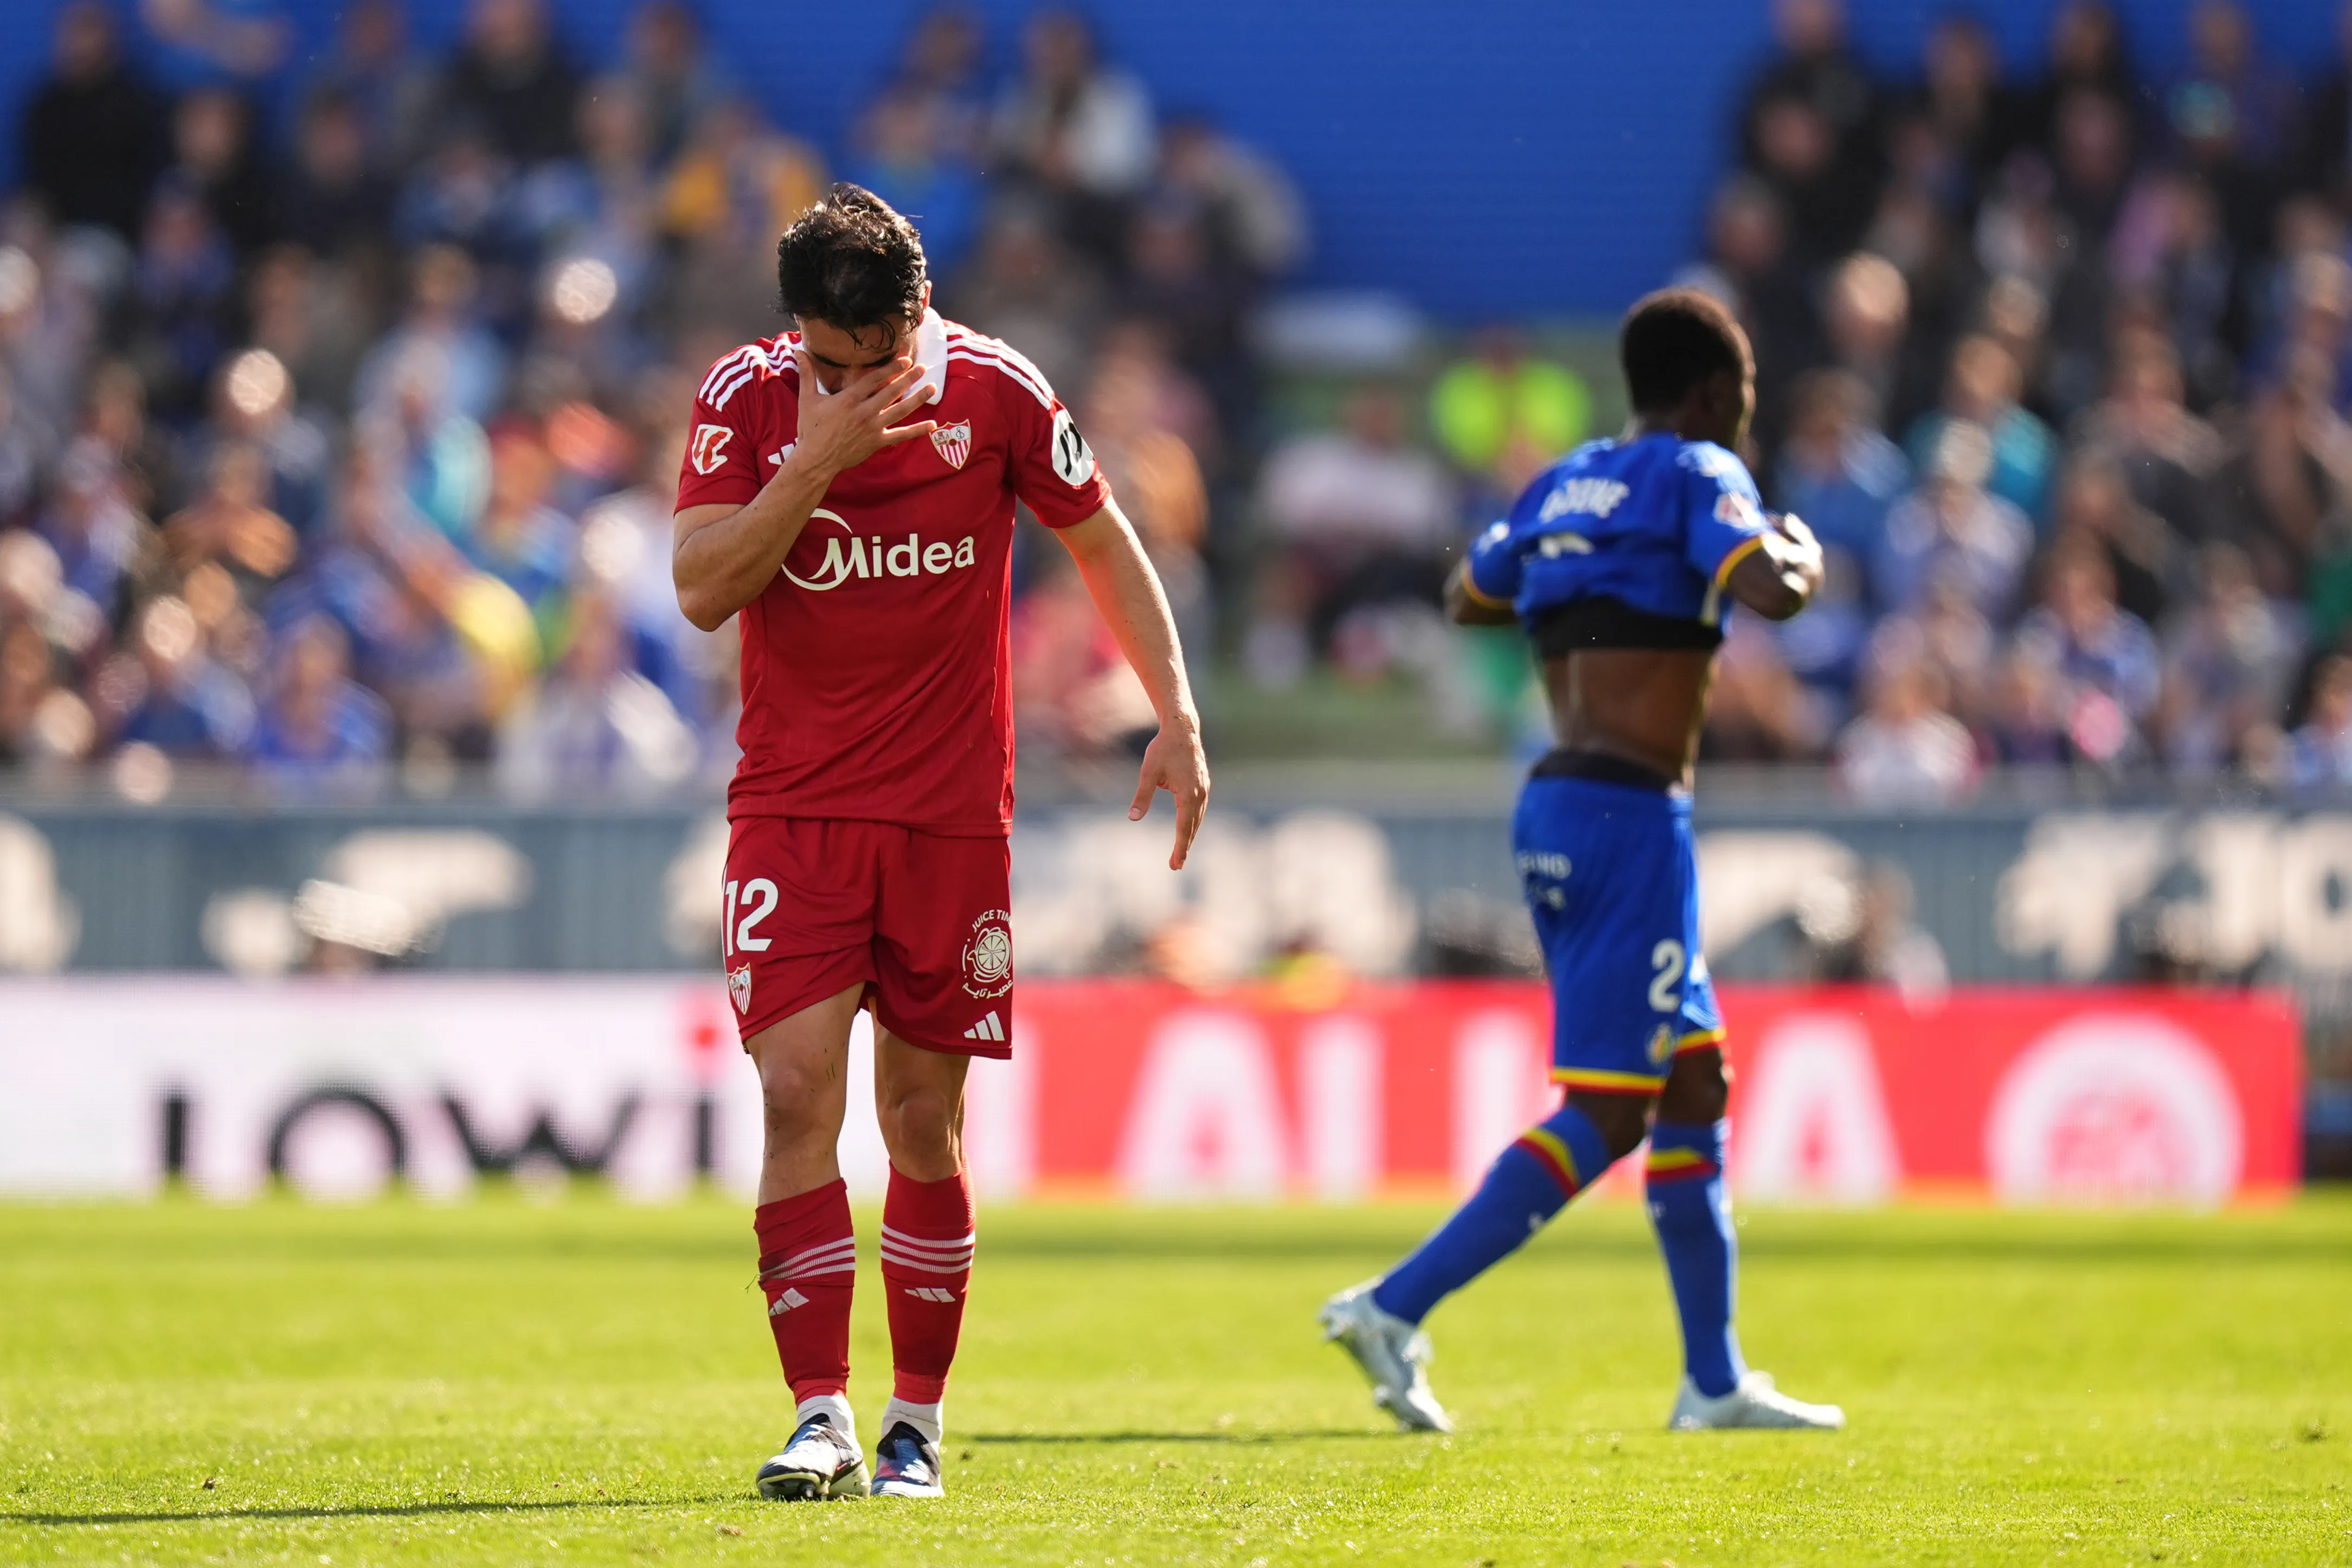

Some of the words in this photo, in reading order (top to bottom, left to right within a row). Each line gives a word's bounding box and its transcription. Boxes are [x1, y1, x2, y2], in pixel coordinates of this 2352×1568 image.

[781, 533, 975, 591] Midea
[724, 878, 779, 957] 12
[972, 909, 995, 933] JUICE
[997, 909, 1012, 929] TIM
[986, 979, 1014, 999] عصير
[1648, 939, 1685, 1013] 2
[964, 1010, 1904, 1205] LALIA
